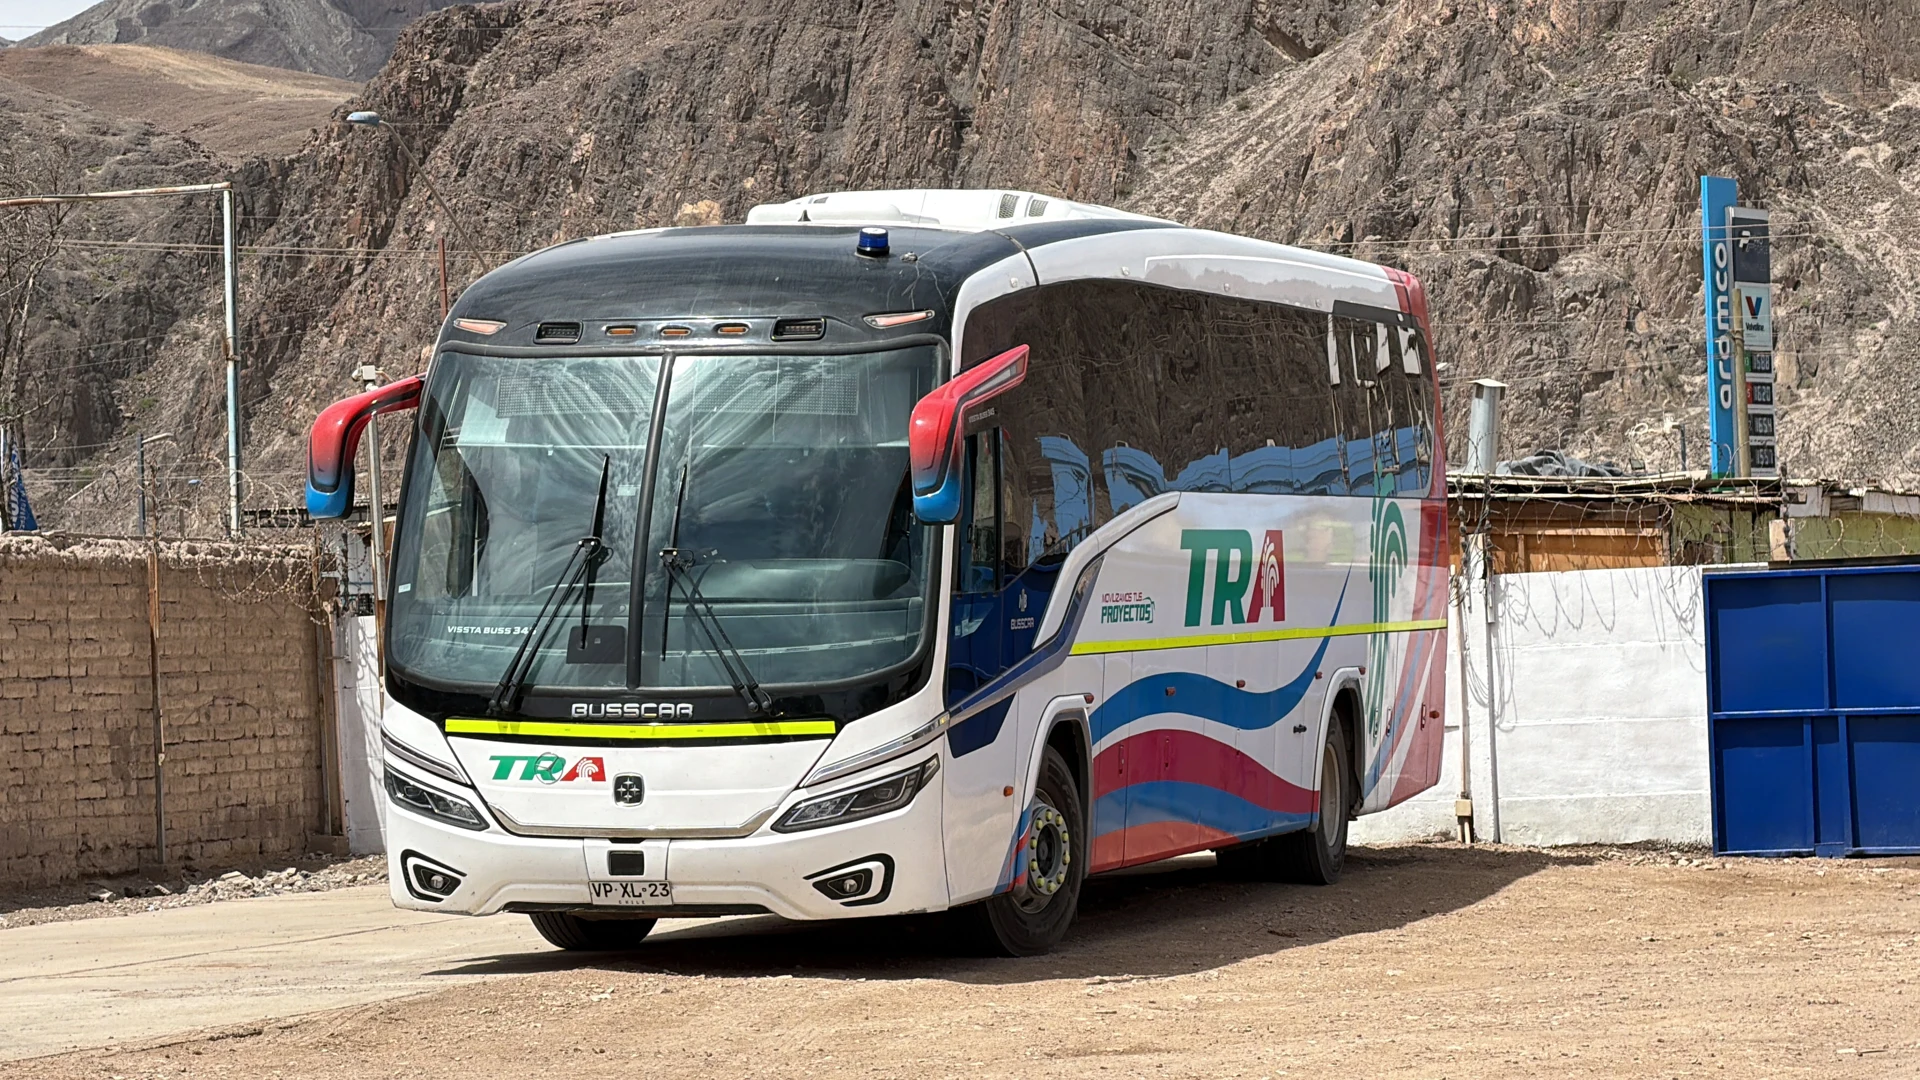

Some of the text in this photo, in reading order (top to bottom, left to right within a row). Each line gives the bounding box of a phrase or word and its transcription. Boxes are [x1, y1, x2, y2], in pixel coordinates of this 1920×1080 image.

[1714, 242, 1732, 410] aramco
[1180, 529, 1286, 627] TRA
[1010, 617, 1035, 630] BUSSCAR
[1101, 603, 1152, 624] PROYECTOS
[447, 626, 481, 634] VISSTA
[483, 626, 512, 634] BUSS
[571, 703, 694, 718] BUSSCAR
[489, 755, 606, 782] TRA
